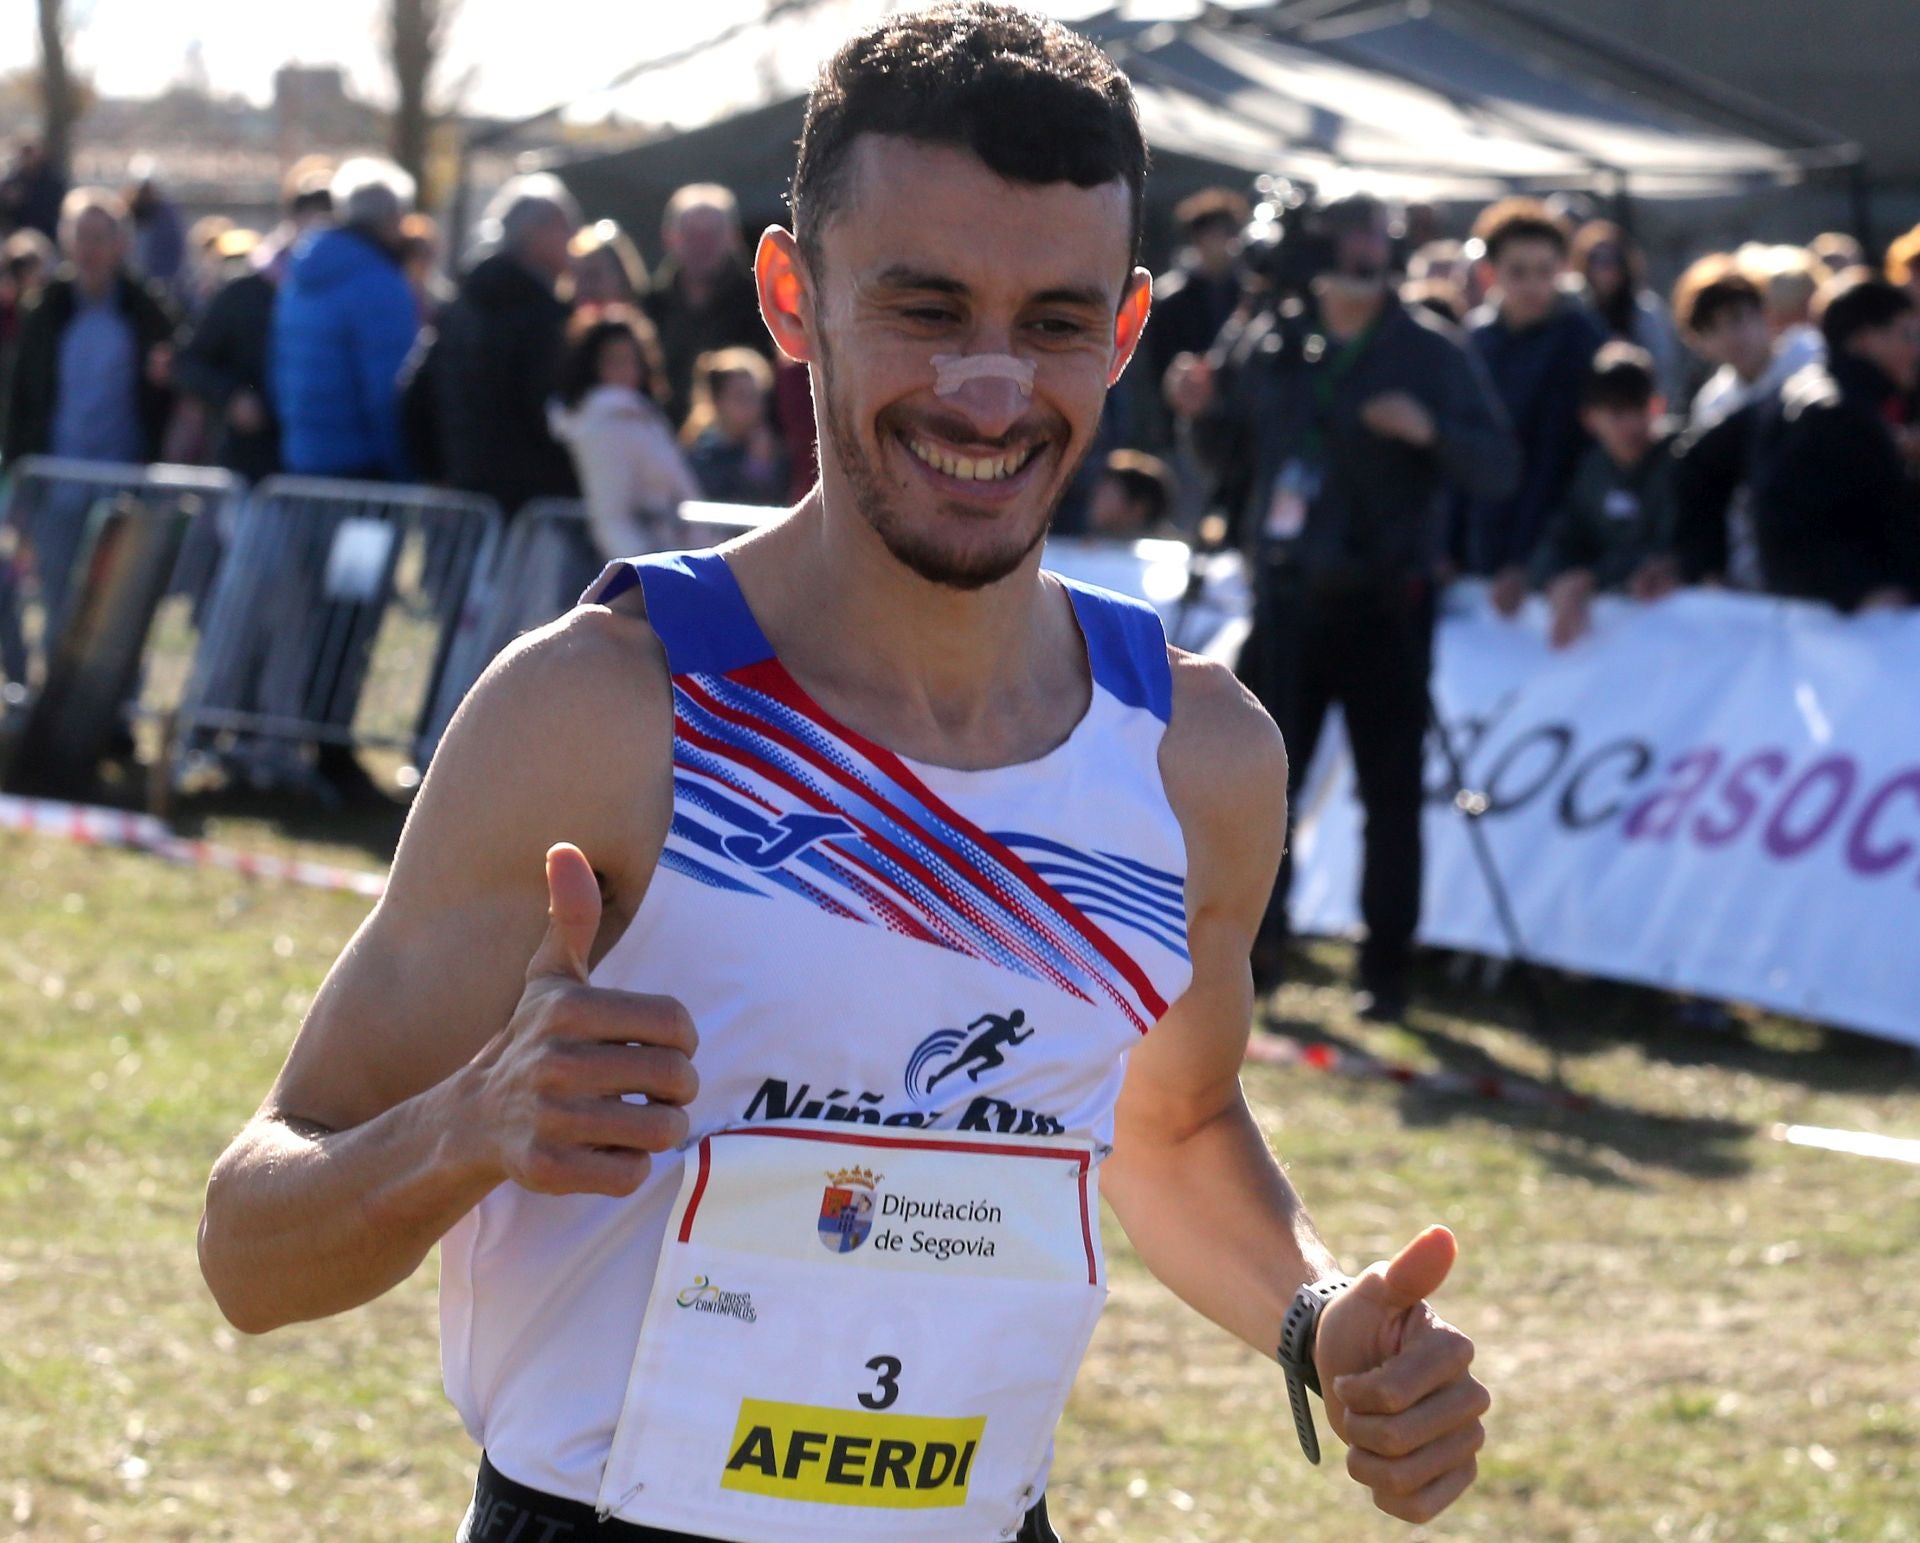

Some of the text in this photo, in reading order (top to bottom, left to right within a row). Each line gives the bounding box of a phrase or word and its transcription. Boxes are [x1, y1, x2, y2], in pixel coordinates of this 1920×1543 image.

[881, 1193, 1002, 1223] Diputación
[874, 1229, 996, 1261] de Segovia
[718, 1291, 748, 1306] CROSS
[856, 1354, 903, 1411] 3
[724, 1425, 977, 1490] AFERDI
